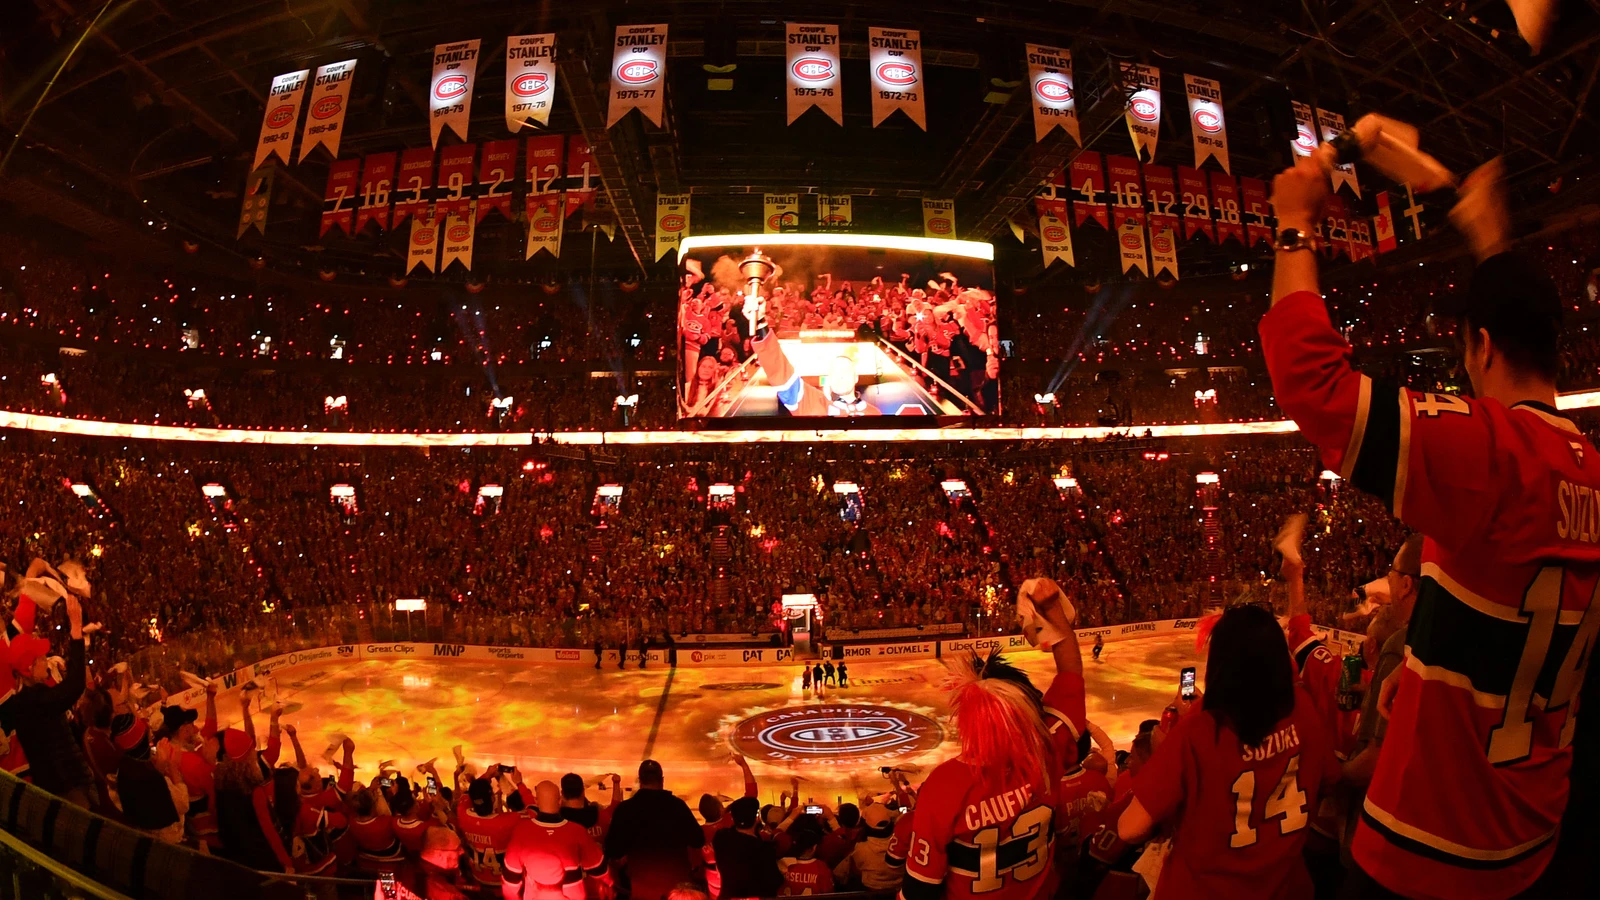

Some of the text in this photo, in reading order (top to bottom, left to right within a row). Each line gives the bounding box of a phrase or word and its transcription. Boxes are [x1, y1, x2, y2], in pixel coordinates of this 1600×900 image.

[617, 35, 665, 46] STANLEY
[789, 34, 837, 44] STANLEY
[871, 37, 918, 50] STANLEY
[435, 49, 477, 65] STANLEY
[509, 46, 554, 59] STANLEY
[1037, 48, 1060, 56] COUPE
[1029, 54, 1071, 68] STANLEY
[326, 64, 346, 73] COUPE
[316, 70, 352, 86] STANLEY
[271, 80, 305, 96] STANLEY
[616, 90, 655, 99] 1976-77
[794, 88, 833, 96] 1975-76
[1187, 84, 1219, 100] STANLEY
[879, 91, 917, 101] 1972-73
[434, 104, 464, 117] 1978-79
[512, 101, 546, 112] 1977-78
[1039, 106, 1073, 117] 1970-71
[1319, 117, 1344, 130] STANLEY
[263, 132, 289, 144] 1992-93
[1197, 135, 1223, 148] 1967-68
[534, 149, 556, 158] MOORE
[489, 168, 505, 197] 2
[530, 164, 559, 196] 12
[580, 162, 592, 192] 1
[406, 176, 422, 204] 3
[447, 172, 463, 201] 9
[1081, 177, 1096, 206] 4
[333, 186, 348, 213] 7
[361, 179, 390, 209] 16
[1114, 181, 1142, 209] 16
[659, 197, 689, 205] STANLEY
[820, 198, 850, 206] STANLEY
[923, 201, 953, 210] STANLEY
[1150, 190, 1178, 217] 12
[1183, 191, 1210, 220] 29
[1217, 198, 1240, 225] 18
[1251, 203, 1265, 227] 5
[1327, 216, 1347, 242] 23
[1351, 220, 1370, 245] 33
[1121, 622, 1156, 634] HELLMANN'S
[1174, 619, 1198, 630] Energ
[1079, 629, 1112, 638] CFMOTO
[949, 640, 1000, 651] Uber Eats
[1009, 637, 1025, 647] Bell
[337, 645, 354, 654] SN
[367, 644, 415, 654] Great Clips
[434, 644, 465, 656] MNP
[887, 646, 922, 654] OLYMEL
[299, 650, 332, 663] Desjardins
[624, 653, 659, 662] xpedia
[743, 650, 763, 662] CAT
[766, 708, 887, 724] CANADIENS
[1241, 724, 1300, 762] SUZUKI
[766, 751, 797, 763] DE
[1230, 754, 1309, 848] 14
[910, 831, 930, 866] 13
[972, 804, 1054, 893] 13
[473, 847, 502, 876] 14
